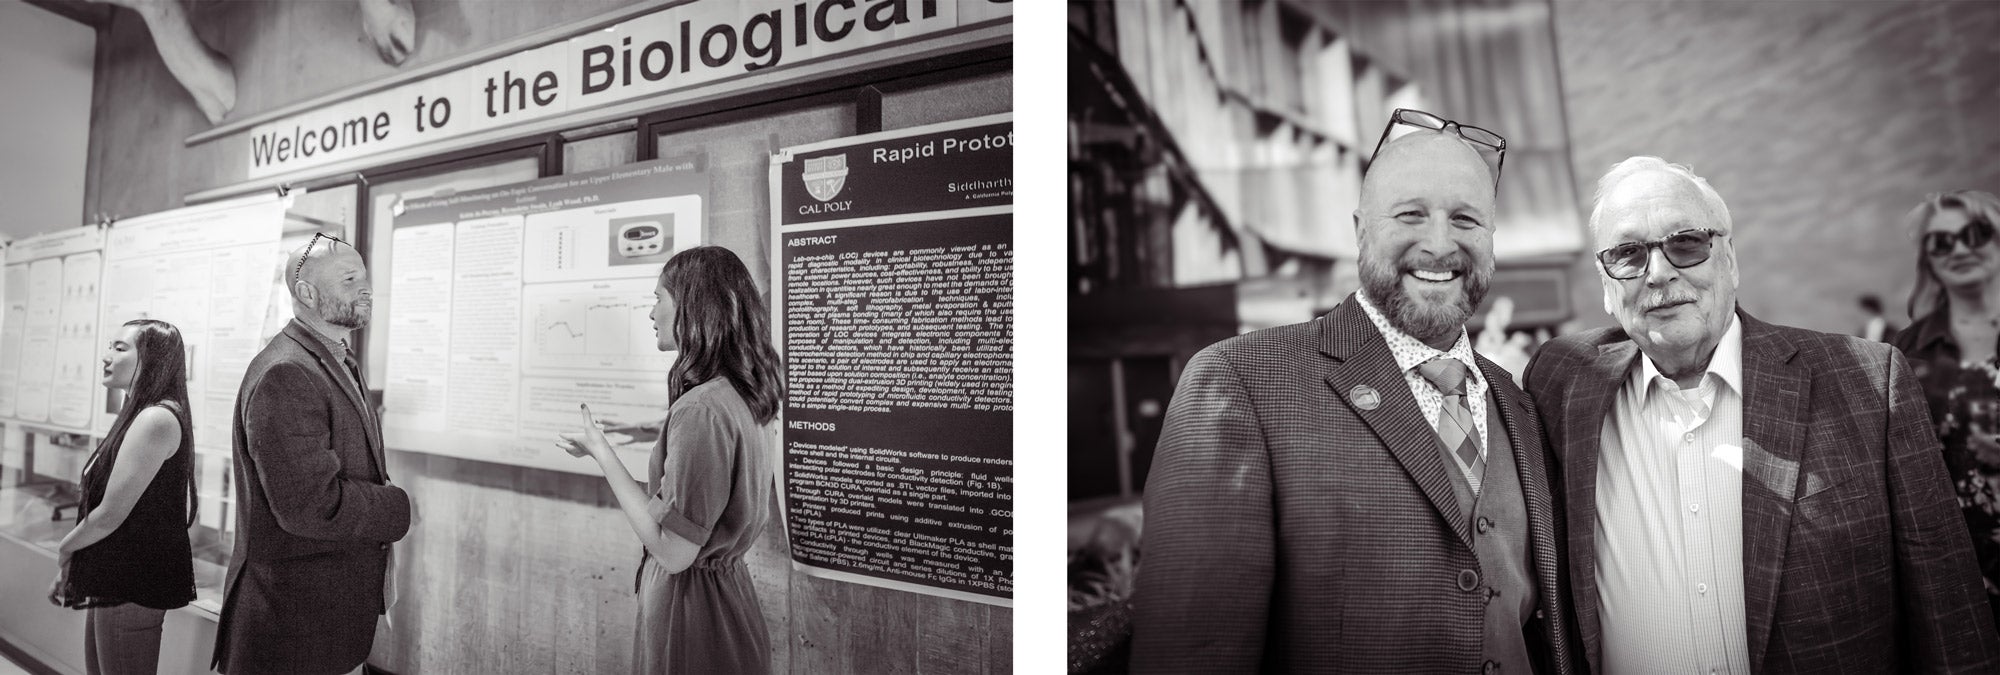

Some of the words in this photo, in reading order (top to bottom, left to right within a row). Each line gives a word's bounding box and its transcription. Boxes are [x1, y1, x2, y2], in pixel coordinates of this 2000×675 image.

[252, 111, 390, 169] Welcome
[415, 96, 451, 132] to
[484, 70, 559, 118] the
[873, 141, 934, 164] Rapid
[612, 169, 652, 180] Elementary
[653, 165, 673, 173] Male
[675, 162, 694, 170] with
[799, 204, 821, 215] CAL
[824, 200, 852, 212] POLY
[787, 235, 837, 247] ABSTRACT
[910, 247, 945, 255] commonly
[914, 254, 962, 262] biotechnology
[961, 266, 982, 274] ability
[936, 302, 978, 310] evaporation
[956, 309, 981, 317] require
[955, 330, 1000, 338] components
[932, 352, 961, 360] capillary
[940, 359, 960, 367] apply
[929, 373, 955, 381] analyte
[908, 380, 933, 388] printing
[935, 380, 960, 388] (widely
[929, 395, 972, 403] conductivity
[974, 404, 990, 412] step
[789, 421, 836, 431] METHODS
[909, 452, 939, 460] software
[951, 455, 981, 463] produce
[901, 466, 924, 476] design
[971, 473, 987, 481] fluid
[888, 474, 928, 484] conductivity
[930, 477, 963, 486] detection
[909, 491, 930, 500] single
[961, 489, 994, 498] imported
[929, 502, 965, 512] translated
[915, 517, 942, 526] additive
[949, 522, 983, 532] extrusion
[894, 530, 911, 538] clear
[913, 533, 947, 543] Ultimaker
[950, 538, 965, 546] PLA
[978, 542, 996, 550] shell
[910, 540, 950, 552] BlackMagic
